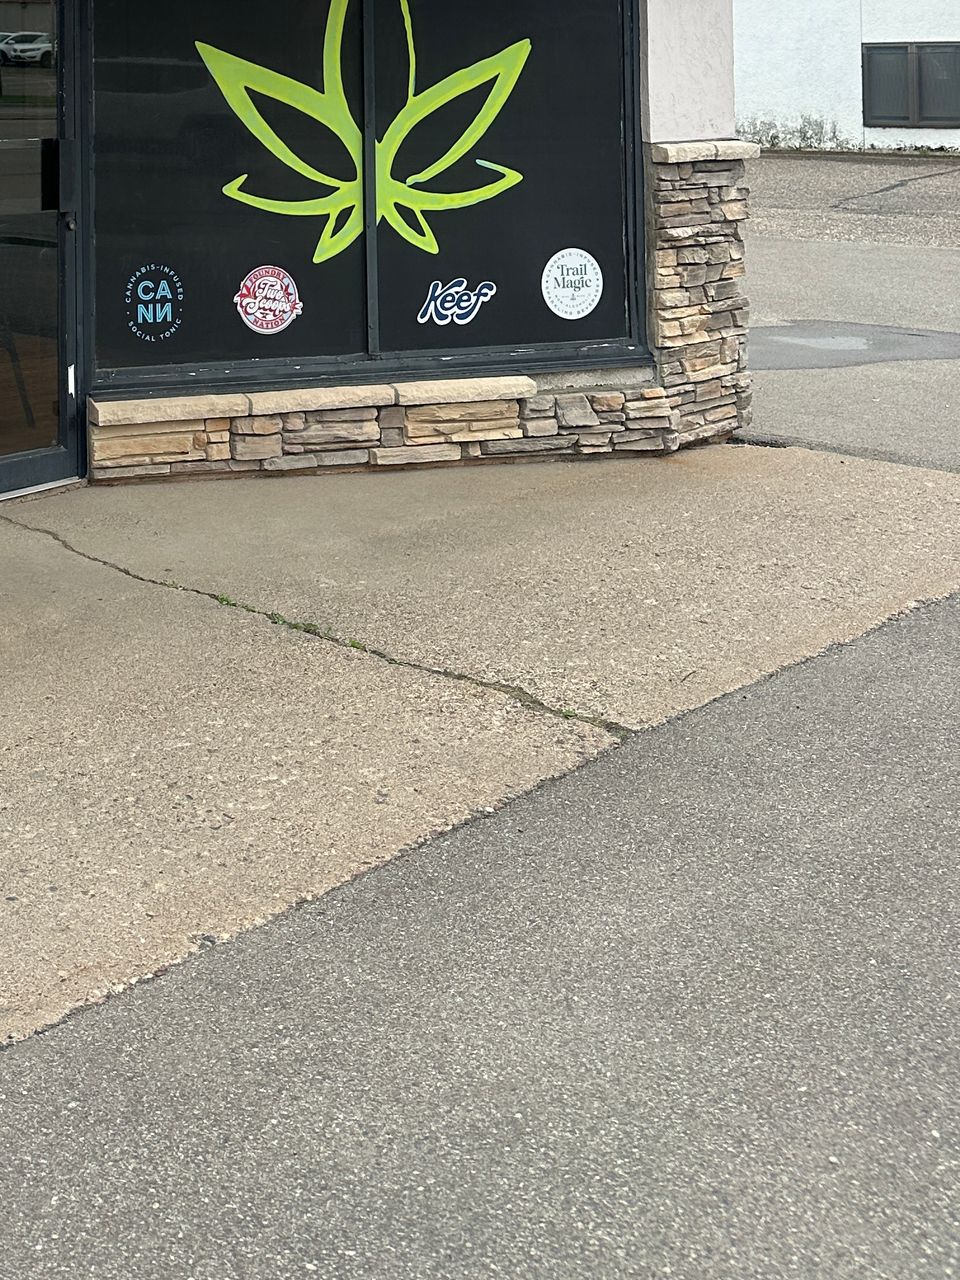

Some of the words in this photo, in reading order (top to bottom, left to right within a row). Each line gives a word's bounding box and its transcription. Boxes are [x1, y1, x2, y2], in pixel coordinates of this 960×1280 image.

[249, 270, 286, 283] FOUNDRY
[557, 263, 588, 276] Trail
[125, 264, 183, 303] CANNABIS-INFUSED
[255, 279, 283, 299] Two
[554, 277, 592, 292] Magic
[241, 295, 291, 317] Scoops
[417, 277, 496, 325] Keef
[128, 321, 156, 341] SOCIAL
[160, 318, 181, 340] TONIC
[253, 316, 285, 328] NATION
